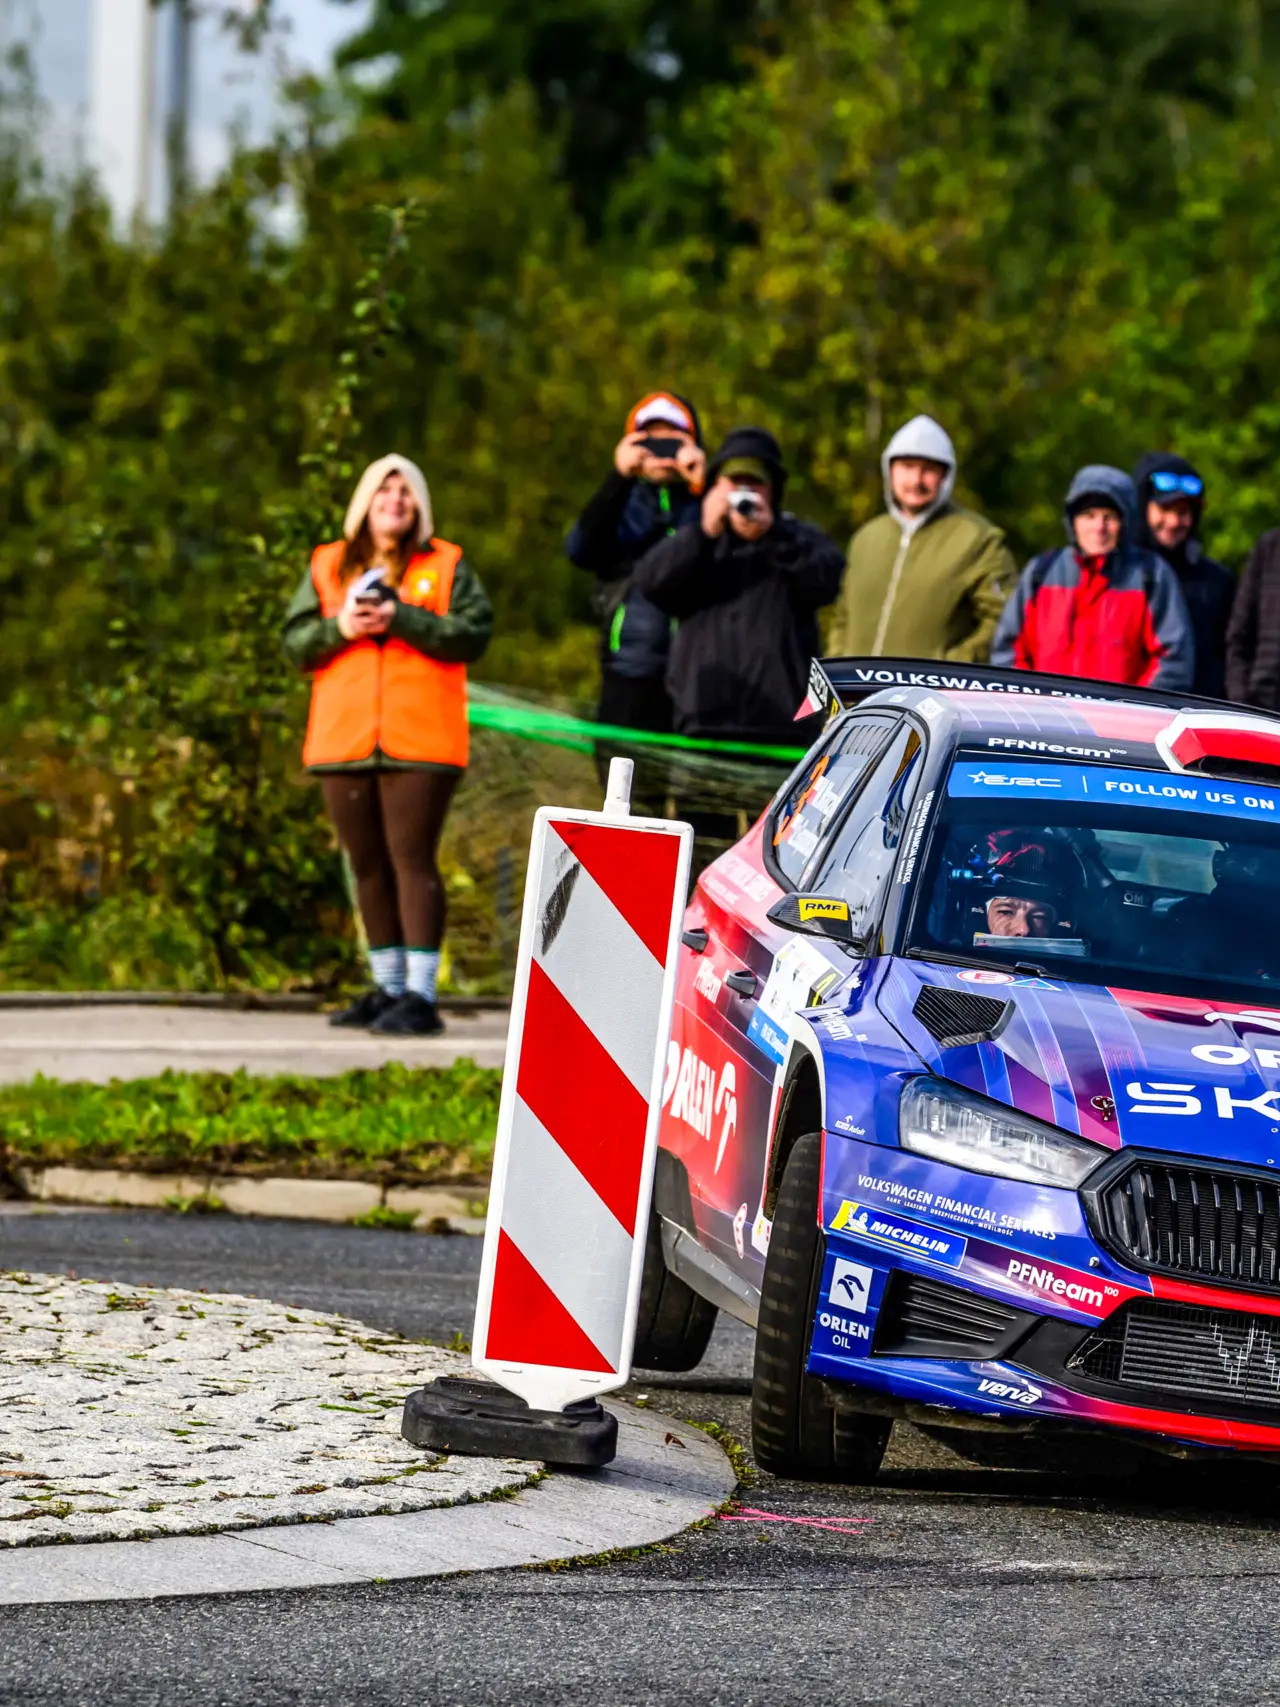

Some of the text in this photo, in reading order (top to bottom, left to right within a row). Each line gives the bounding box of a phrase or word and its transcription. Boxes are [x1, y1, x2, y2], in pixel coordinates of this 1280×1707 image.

[1105, 781, 1198, 800] FOLLOW
[1205, 791, 1236, 805] US
[1243, 796, 1275, 811] ON
[805, 902, 842, 911] RMF
[857, 1174, 1057, 1241] VOLKSWAGEN FINANCIAL SERVICES
[904, 1201, 927, 1212] LEASING
[870, 1220, 950, 1254] MICHELIN
[819, 1313, 871, 1340] ORLEN
[832, 1334, 851, 1350] OIL
[977, 1379, 1042, 1405] verva
